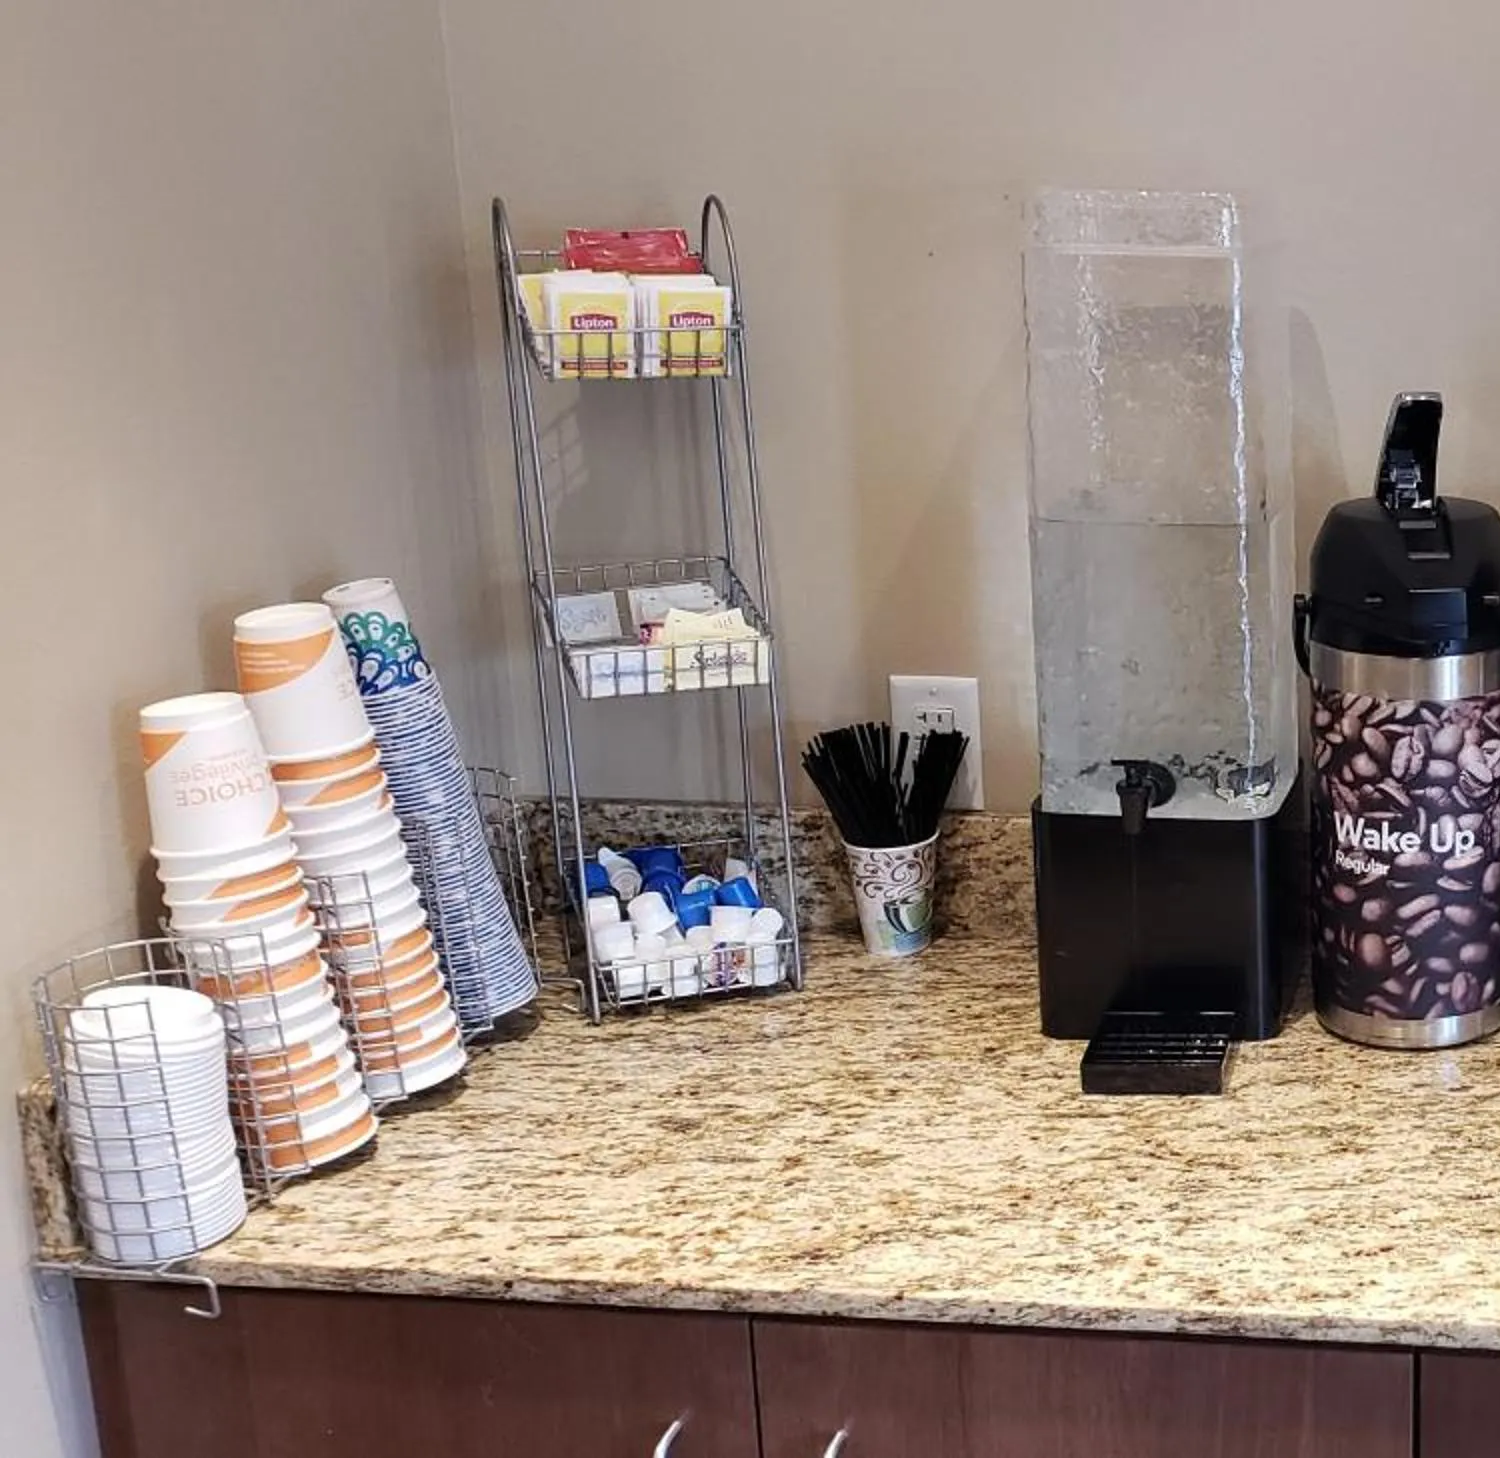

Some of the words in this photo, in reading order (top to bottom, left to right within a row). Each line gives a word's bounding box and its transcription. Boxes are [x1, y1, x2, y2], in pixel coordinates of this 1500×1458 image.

[573, 318, 614, 330] Lipton
[673, 314, 712, 328] Lipton
[175, 771, 265, 807] CHOICE
[1334, 811, 1422, 853] Wake
[1430, 823, 1475, 858] Up
[1335, 850, 1391, 875] Regular
